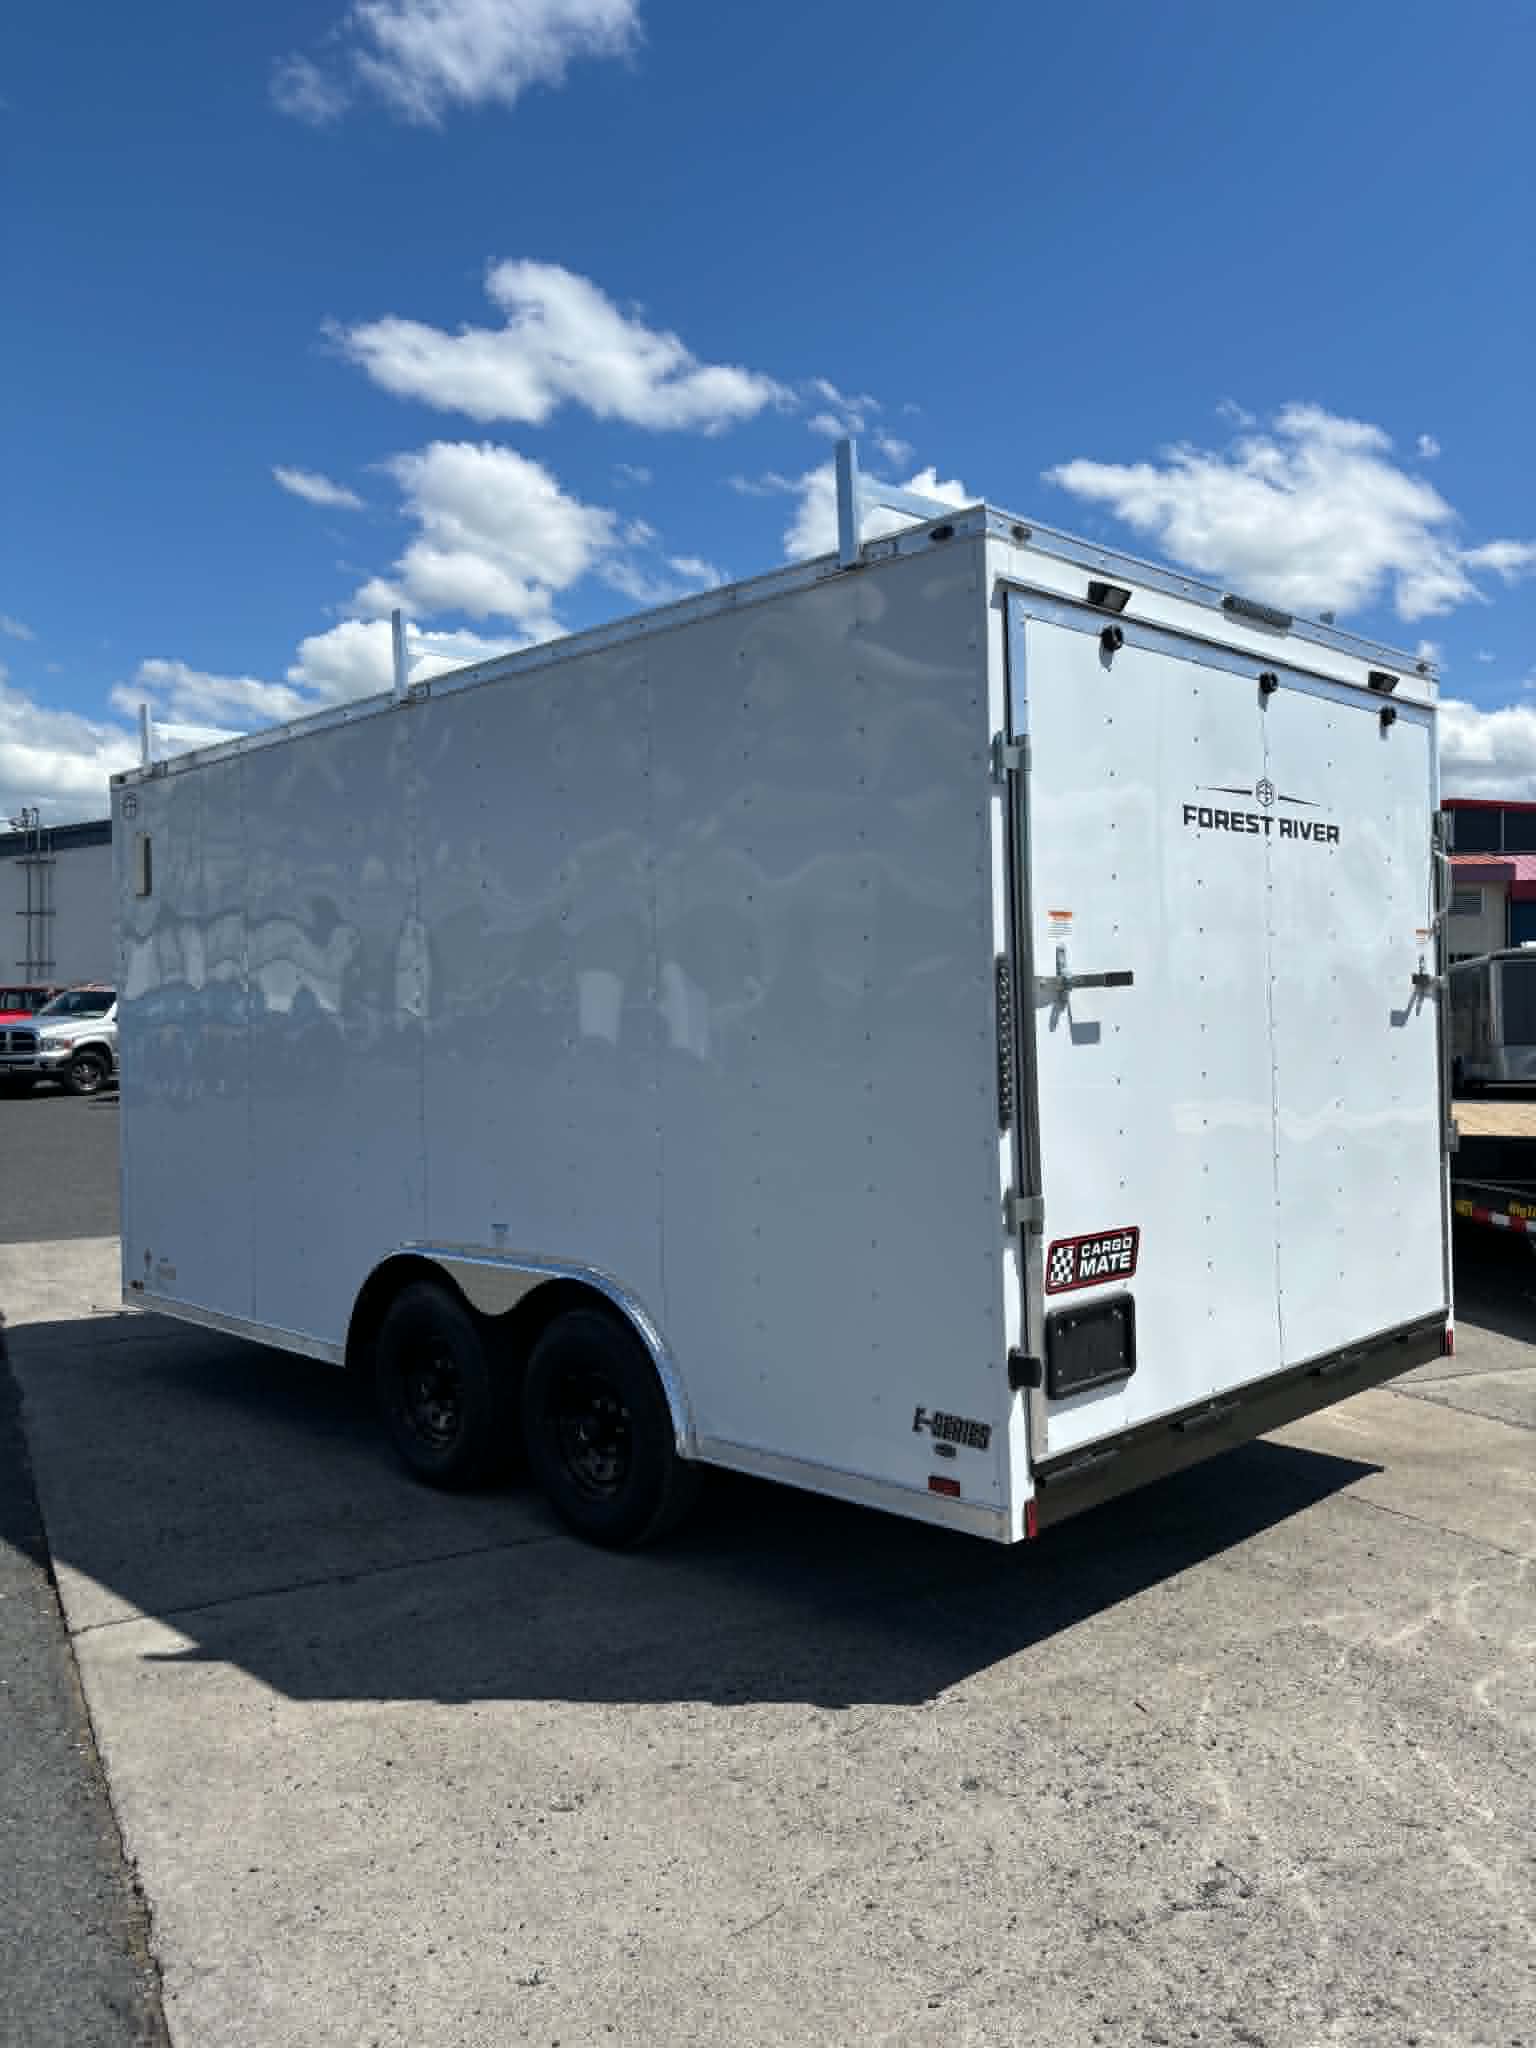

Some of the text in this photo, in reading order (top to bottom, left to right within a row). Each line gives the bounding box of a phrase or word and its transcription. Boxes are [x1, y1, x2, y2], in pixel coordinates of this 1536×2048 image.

[1183, 804, 1340, 845] FOREST RIVER
[1081, 1236, 1133, 1258] CARGO
[1080, 1250, 1132, 1278] MATE
